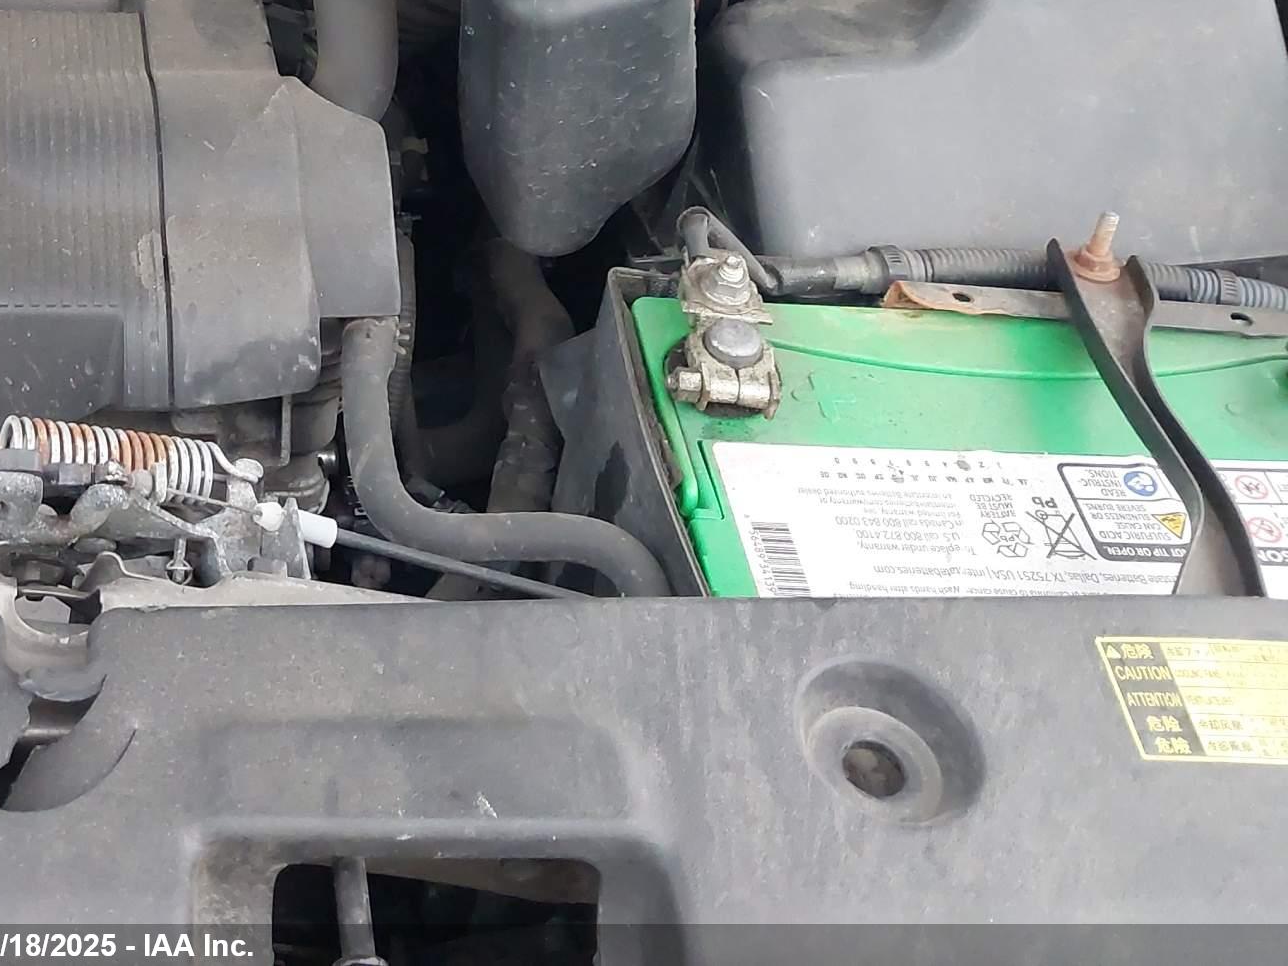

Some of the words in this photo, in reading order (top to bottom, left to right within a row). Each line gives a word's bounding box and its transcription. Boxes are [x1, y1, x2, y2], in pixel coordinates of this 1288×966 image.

[1100, 487, 1127, 497] READ
[969, 493, 1013, 503] RECYCLED
[1031, 496, 1058, 509] Pb
[975, 501, 989, 510] BE
[990, 501, 1014, 511] MUST
[1114, 504, 1147, 513] SEVERE
[979, 509, 1016, 519] BATTERY
[1090, 512, 1105, 521] OR
[918, 518, 955, 530] Canada
[1115, 521, 1142, 531] CAUSE
[1142, 522, 1163, 532] CAN
[1098, 530, 1123, 539] ACID
[1122, 530, 1172, 542] SULFURIC
[901, 543, 929, 554] under
[1103, 545, 1135, 556] OPEN.
[1136, 546, 1152, 557] OR
[1152, 546, 1170, 557] TIP
[991, 569, 1016, 581] USA
[1016, 570, 1053, 583] 75251
[1052, 572, 1066, 583] TX
[1065, 571, 1100, 584] Dallas,
[1114, 665, 1173, 681] CAUTION
[1126, 691, 1184, 707] ATTENTION
